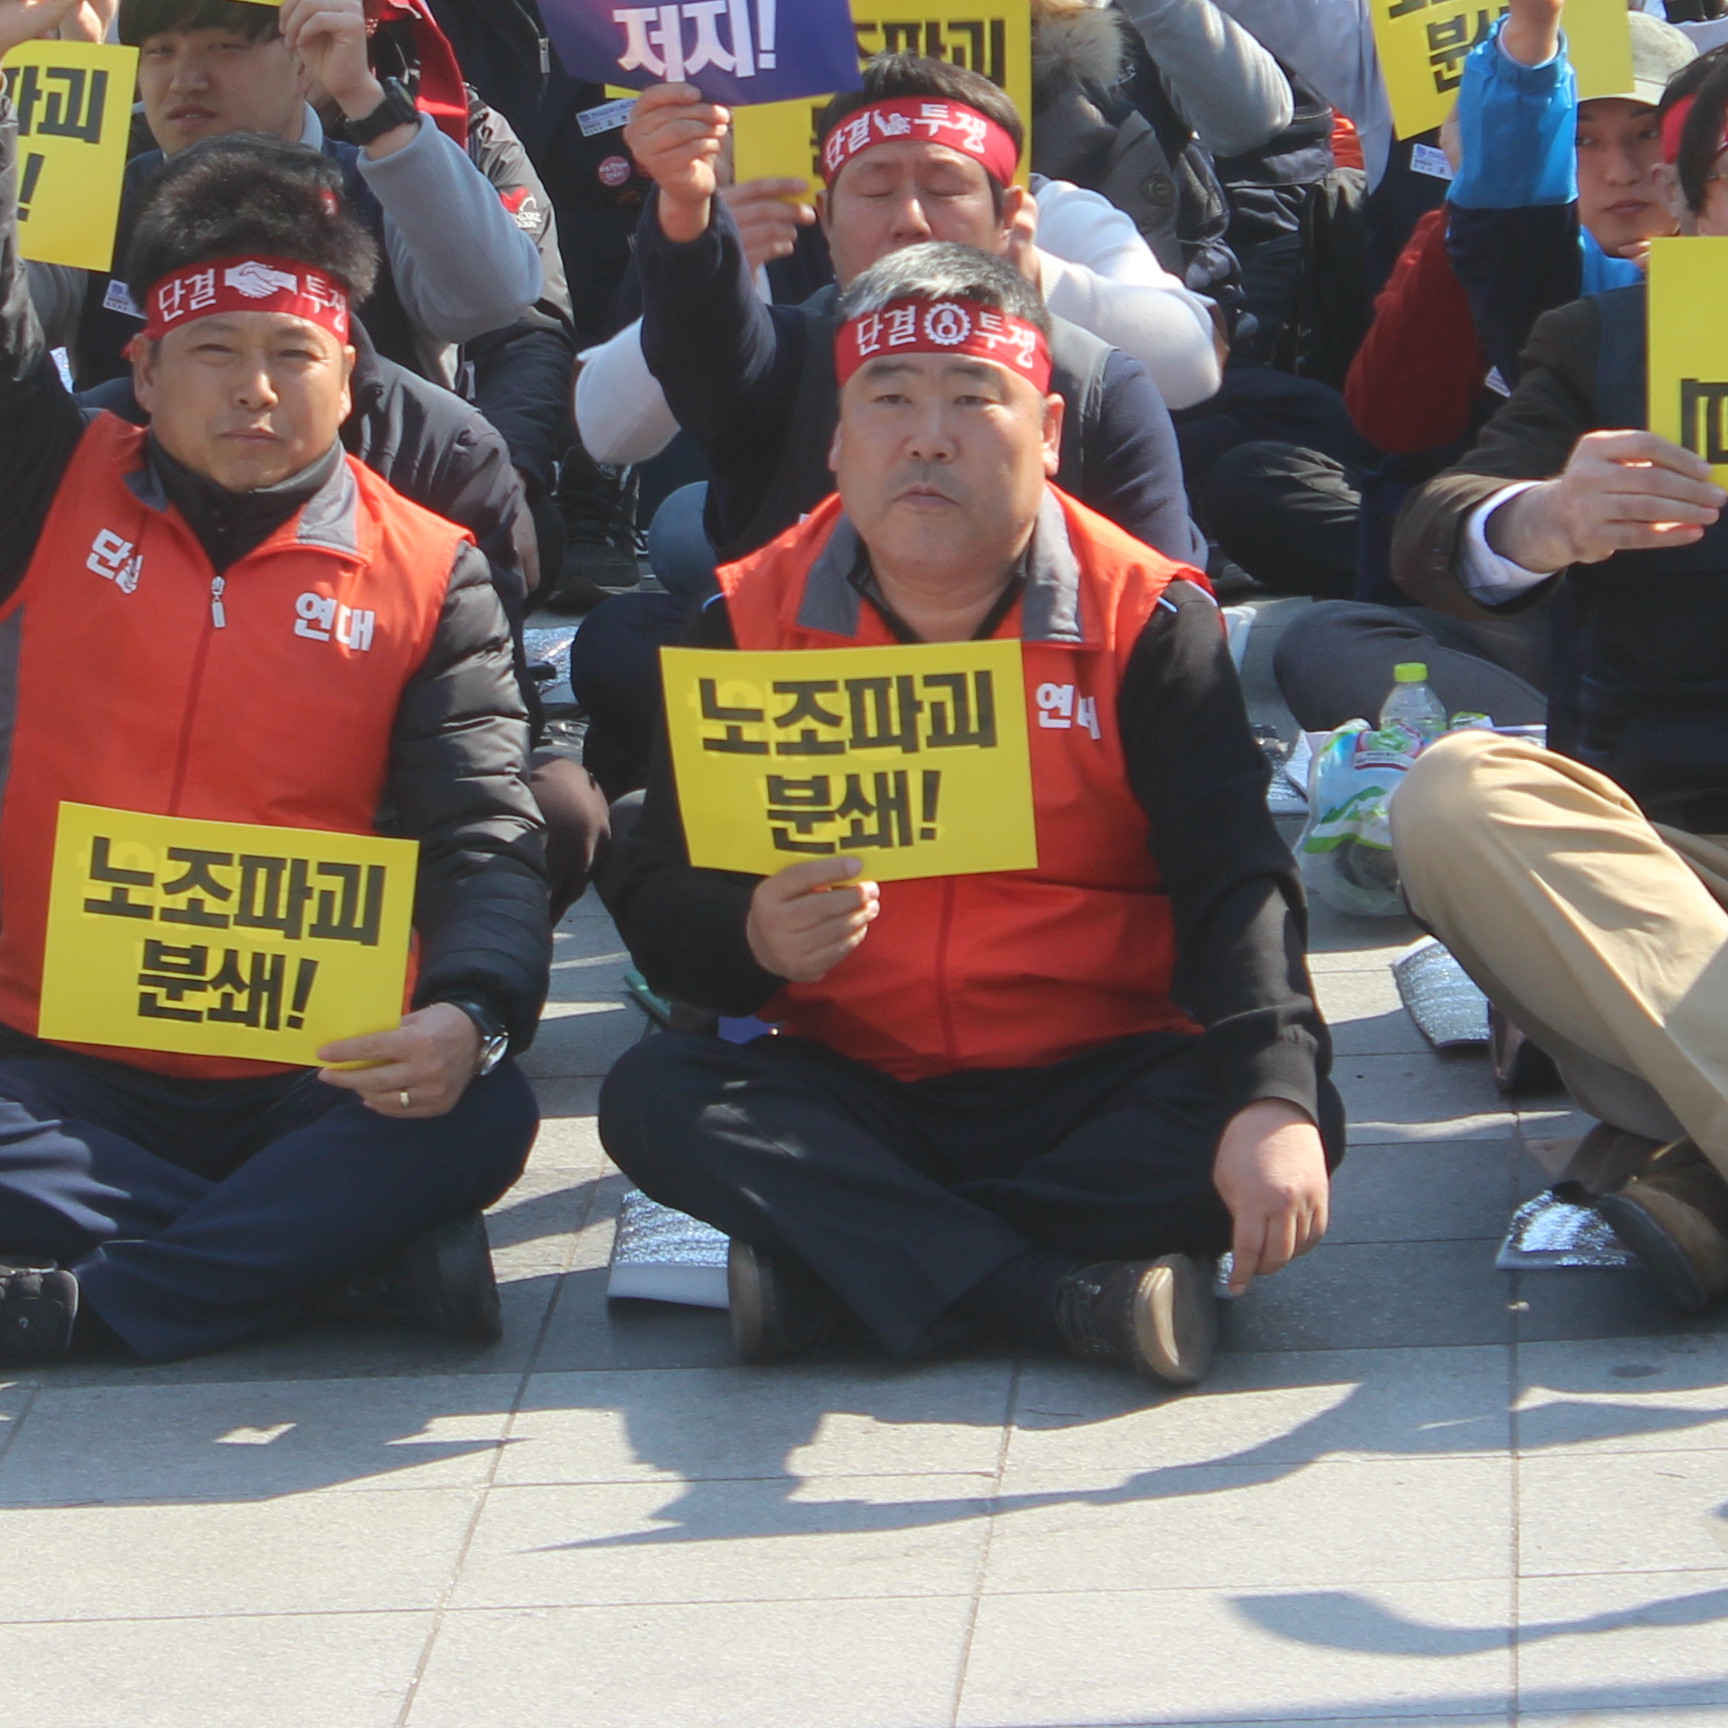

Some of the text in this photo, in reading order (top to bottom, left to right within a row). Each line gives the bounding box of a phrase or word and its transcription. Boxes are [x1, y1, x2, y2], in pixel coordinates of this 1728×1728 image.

[821, 102, 991, 178] 단결 투쟁
[156, 270, 350, 336] 단결 투쟁
[853, 300, 1040, 373] 단결 투쟁
[293, 590, 376, 653] 연대
[695, 666, 999, 759] 노조파괴
[764, 767, 943, 857] 분쇄!
[82, 835, 389, 948] 노조파괴
[135, 939, 320, 1034] 분쇄!
